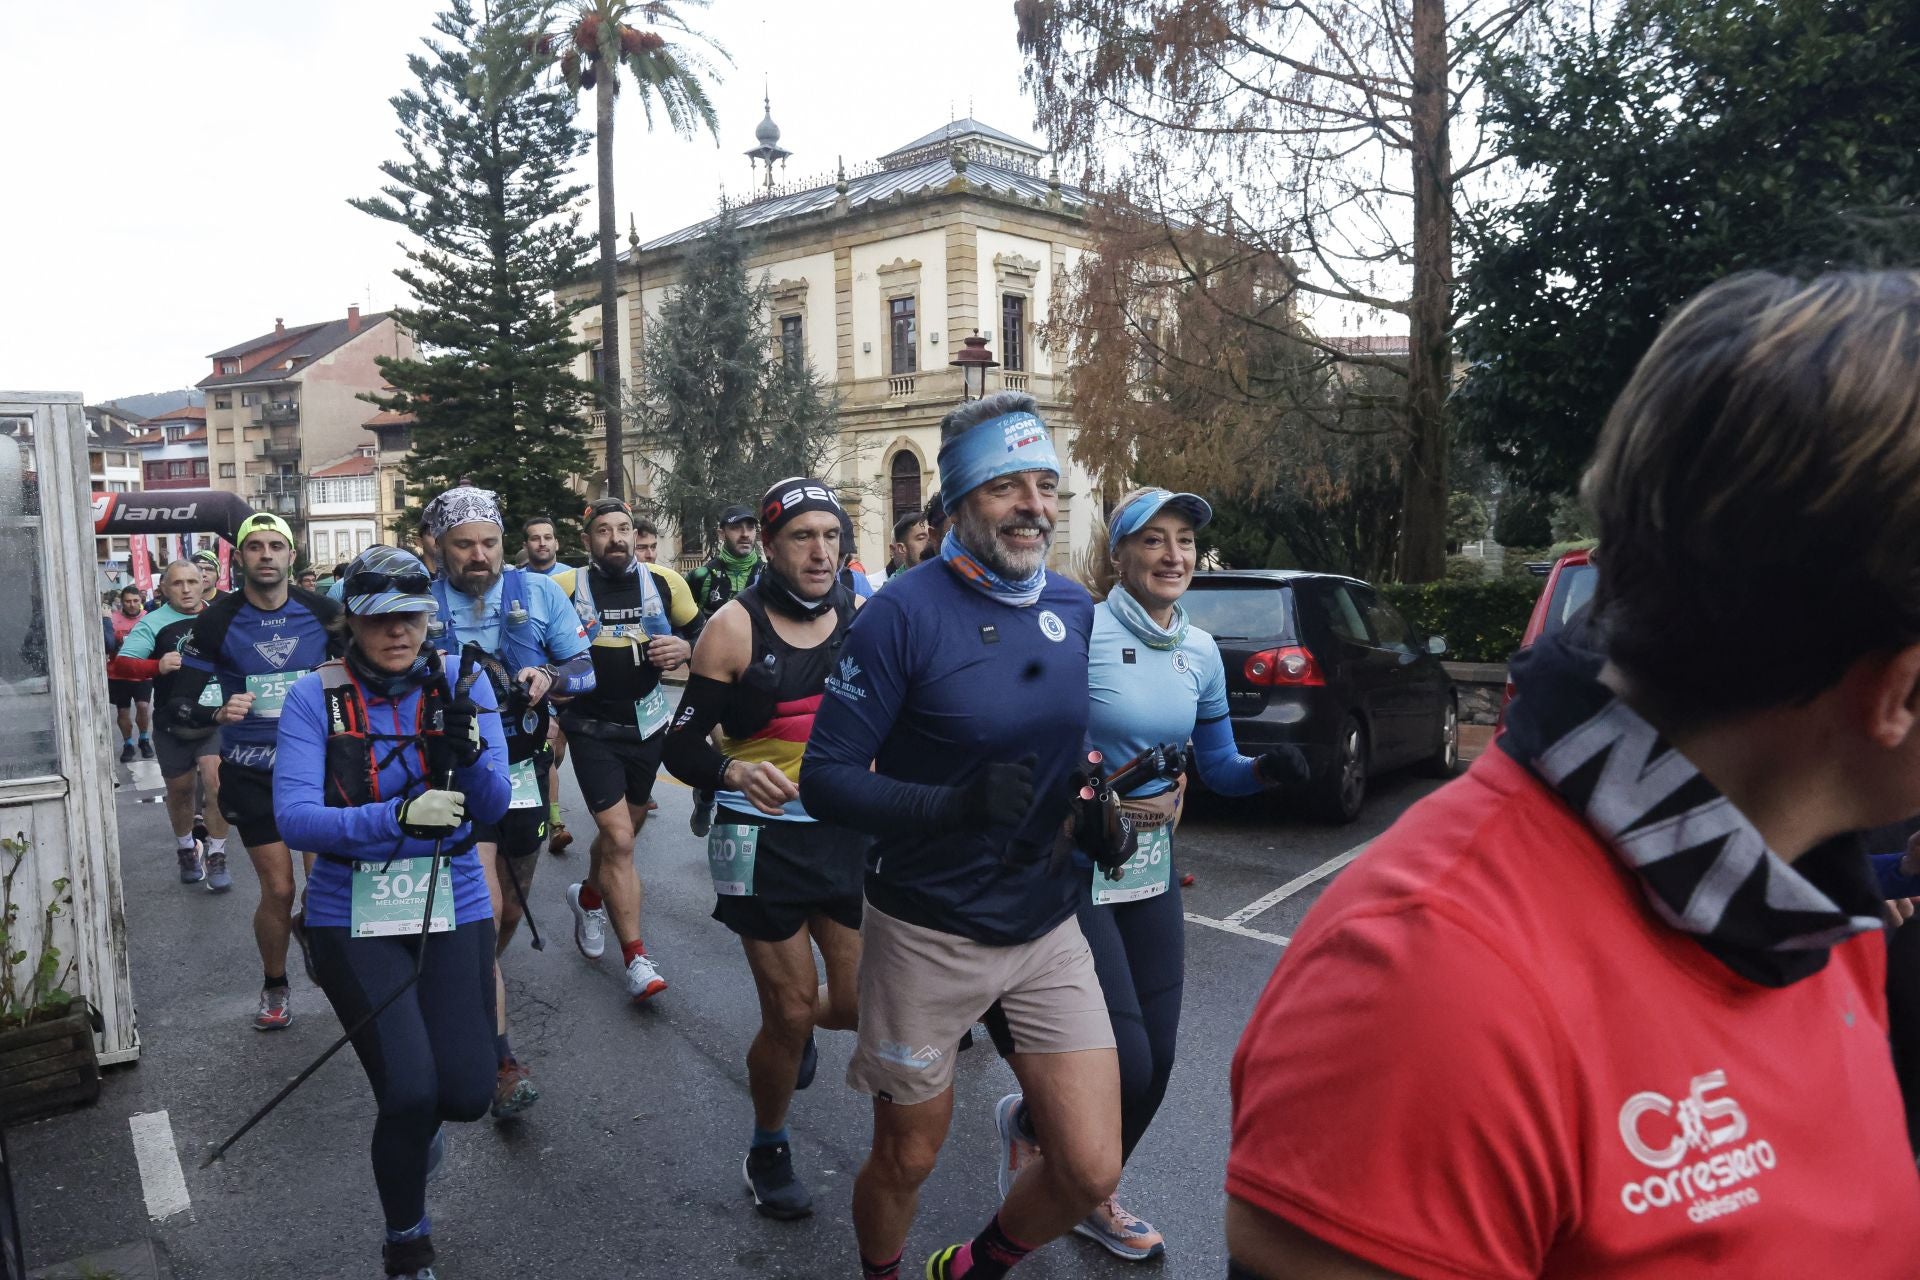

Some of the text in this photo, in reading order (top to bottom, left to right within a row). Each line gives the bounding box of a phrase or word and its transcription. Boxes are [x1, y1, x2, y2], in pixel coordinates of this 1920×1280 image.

[1004, 418, 1036, 435] MONT
[370, 872, 432, 900] 304
[375, 897, 427, 907] MELONZTRA
